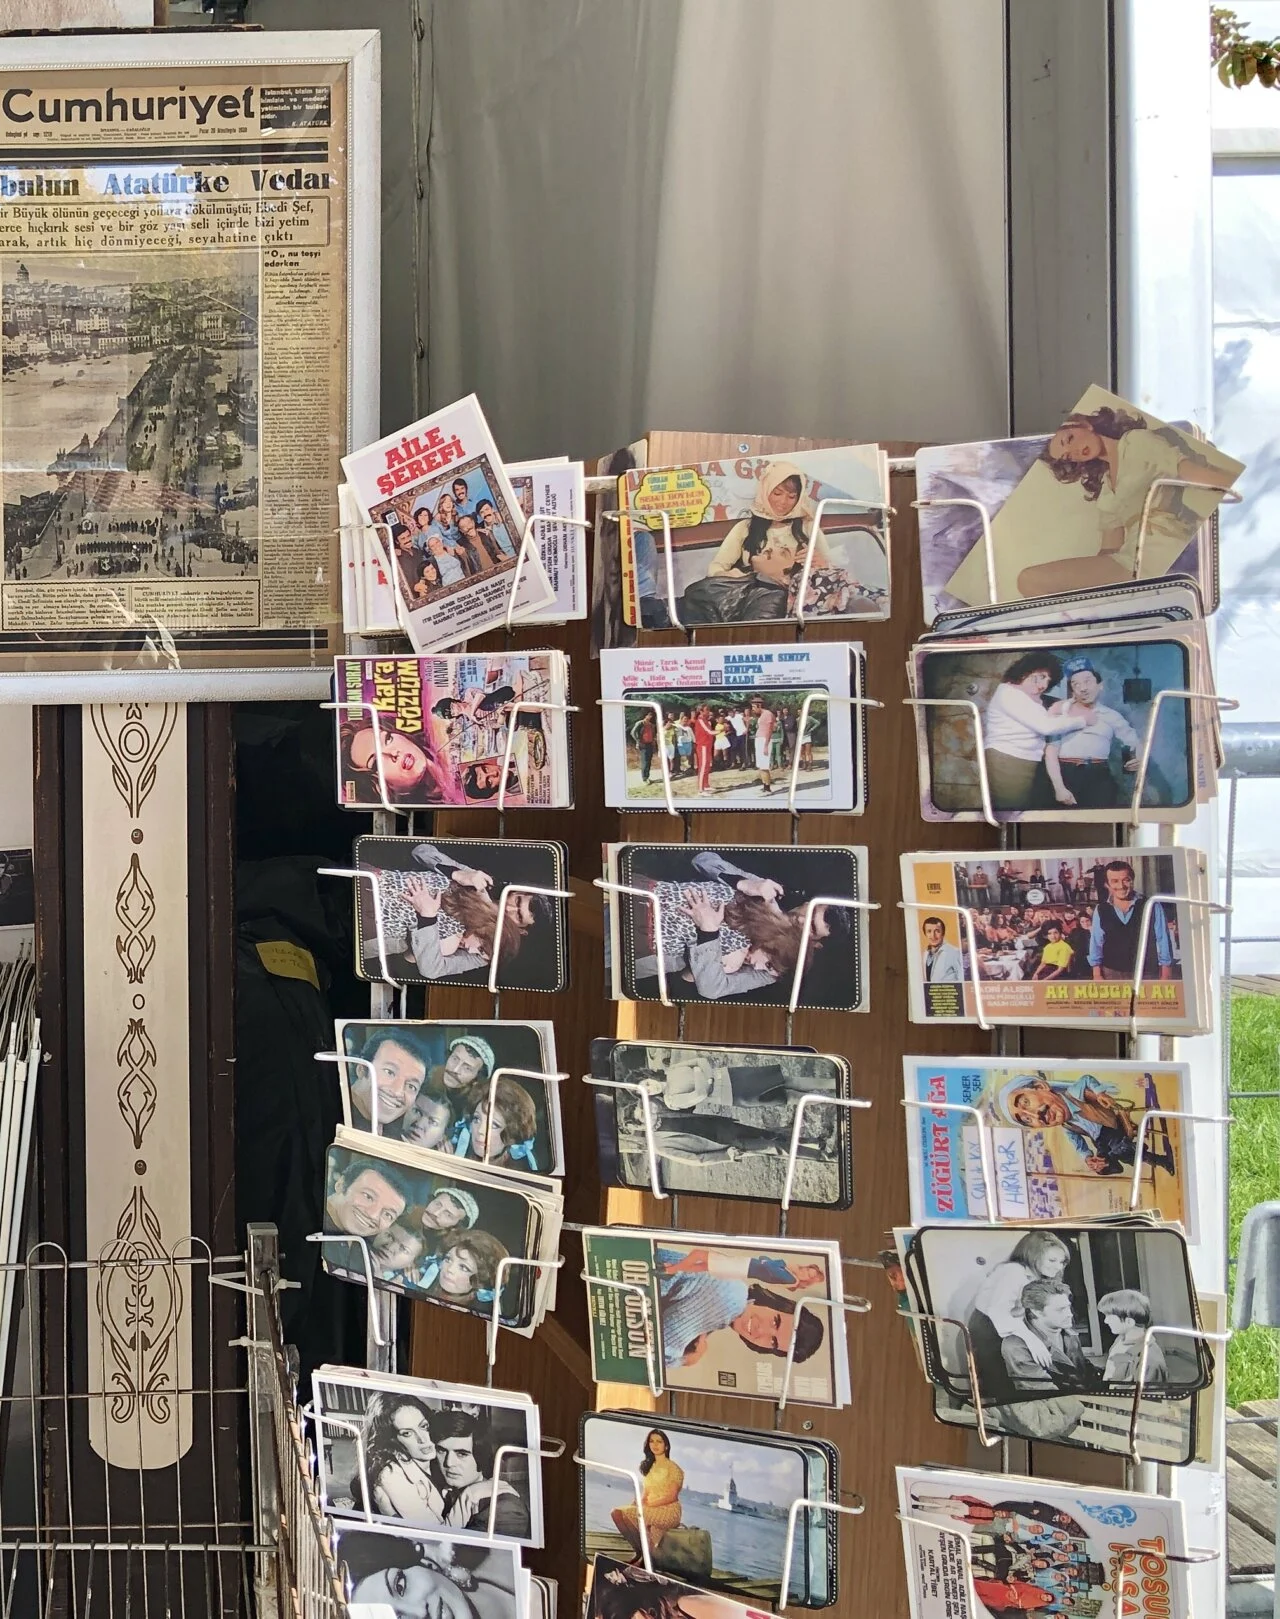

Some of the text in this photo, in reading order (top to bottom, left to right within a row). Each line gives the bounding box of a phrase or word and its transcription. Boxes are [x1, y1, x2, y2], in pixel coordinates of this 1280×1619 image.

[2, 85, 255, 125] Cumhuriyet
[103, 171, 230, 196] Atatürke
[13, 207, 53, 220] Büyük
[53, 206, 89, 218] ölünün
[185, 203, 252, 216] dökülmüştü;
[292, 200, 314, 215] Şef,
[28, 221, 69, 235] hıçkırık
[74, 221, 95, 232] sesi
[101, 224, 113, 232] ve
[118, 220, 134, 232] bir
[139, 220, 158, 233] göz
[191, 218, 209, 229] seli
[216, 217, 249, 231] içinde
[255, 217, 275, 228] bizi
[279, 217, 310, 231] yetim
[36, 237, 67, 247] artık
[75, 236, 93, 249] hiç
[100, 234, 182, 249] dönmiyeceği,
[188, 233, 257, 247] seyahatine
[264, 232, 293, 243] çıktı
[385, 427, 445, 470] AİLE
[376, 434, 466, 496] ŞEREFİ
[723, 653, 773, 665] HABABAM
[346, 661, 363, 688] ŞORAY
[432, 660, 449, 688] İNANIR
[723, 675, 755, 685] KALDI
[1044, 984, 1069, 999] AH
[1151, 983, 1176, 999] AH
[961, 1075, 974, 1103] ŞENER
[972, 1075, 984, 1093] ŞEN
[927, 1075, 955, 1213] ZÜĞÜRT AĞA
[621, 1259, 656, 1360] OH OLSUN
[947, 1540, 956, 1563] MÜJDE
[927, 1549, 939, 1598] KARTAL TİBET
[938, 1532, 947, 1553] AYŞEN
[943, 1578, 951, 1598] ERGİN
[949, 1565, 956, 1574] AR
[956, 1558, 964, 1580] SUNAL
[950, 1578, 958, 1600] ŞENER
[958, 1584, 966, 1602] ADİLE
